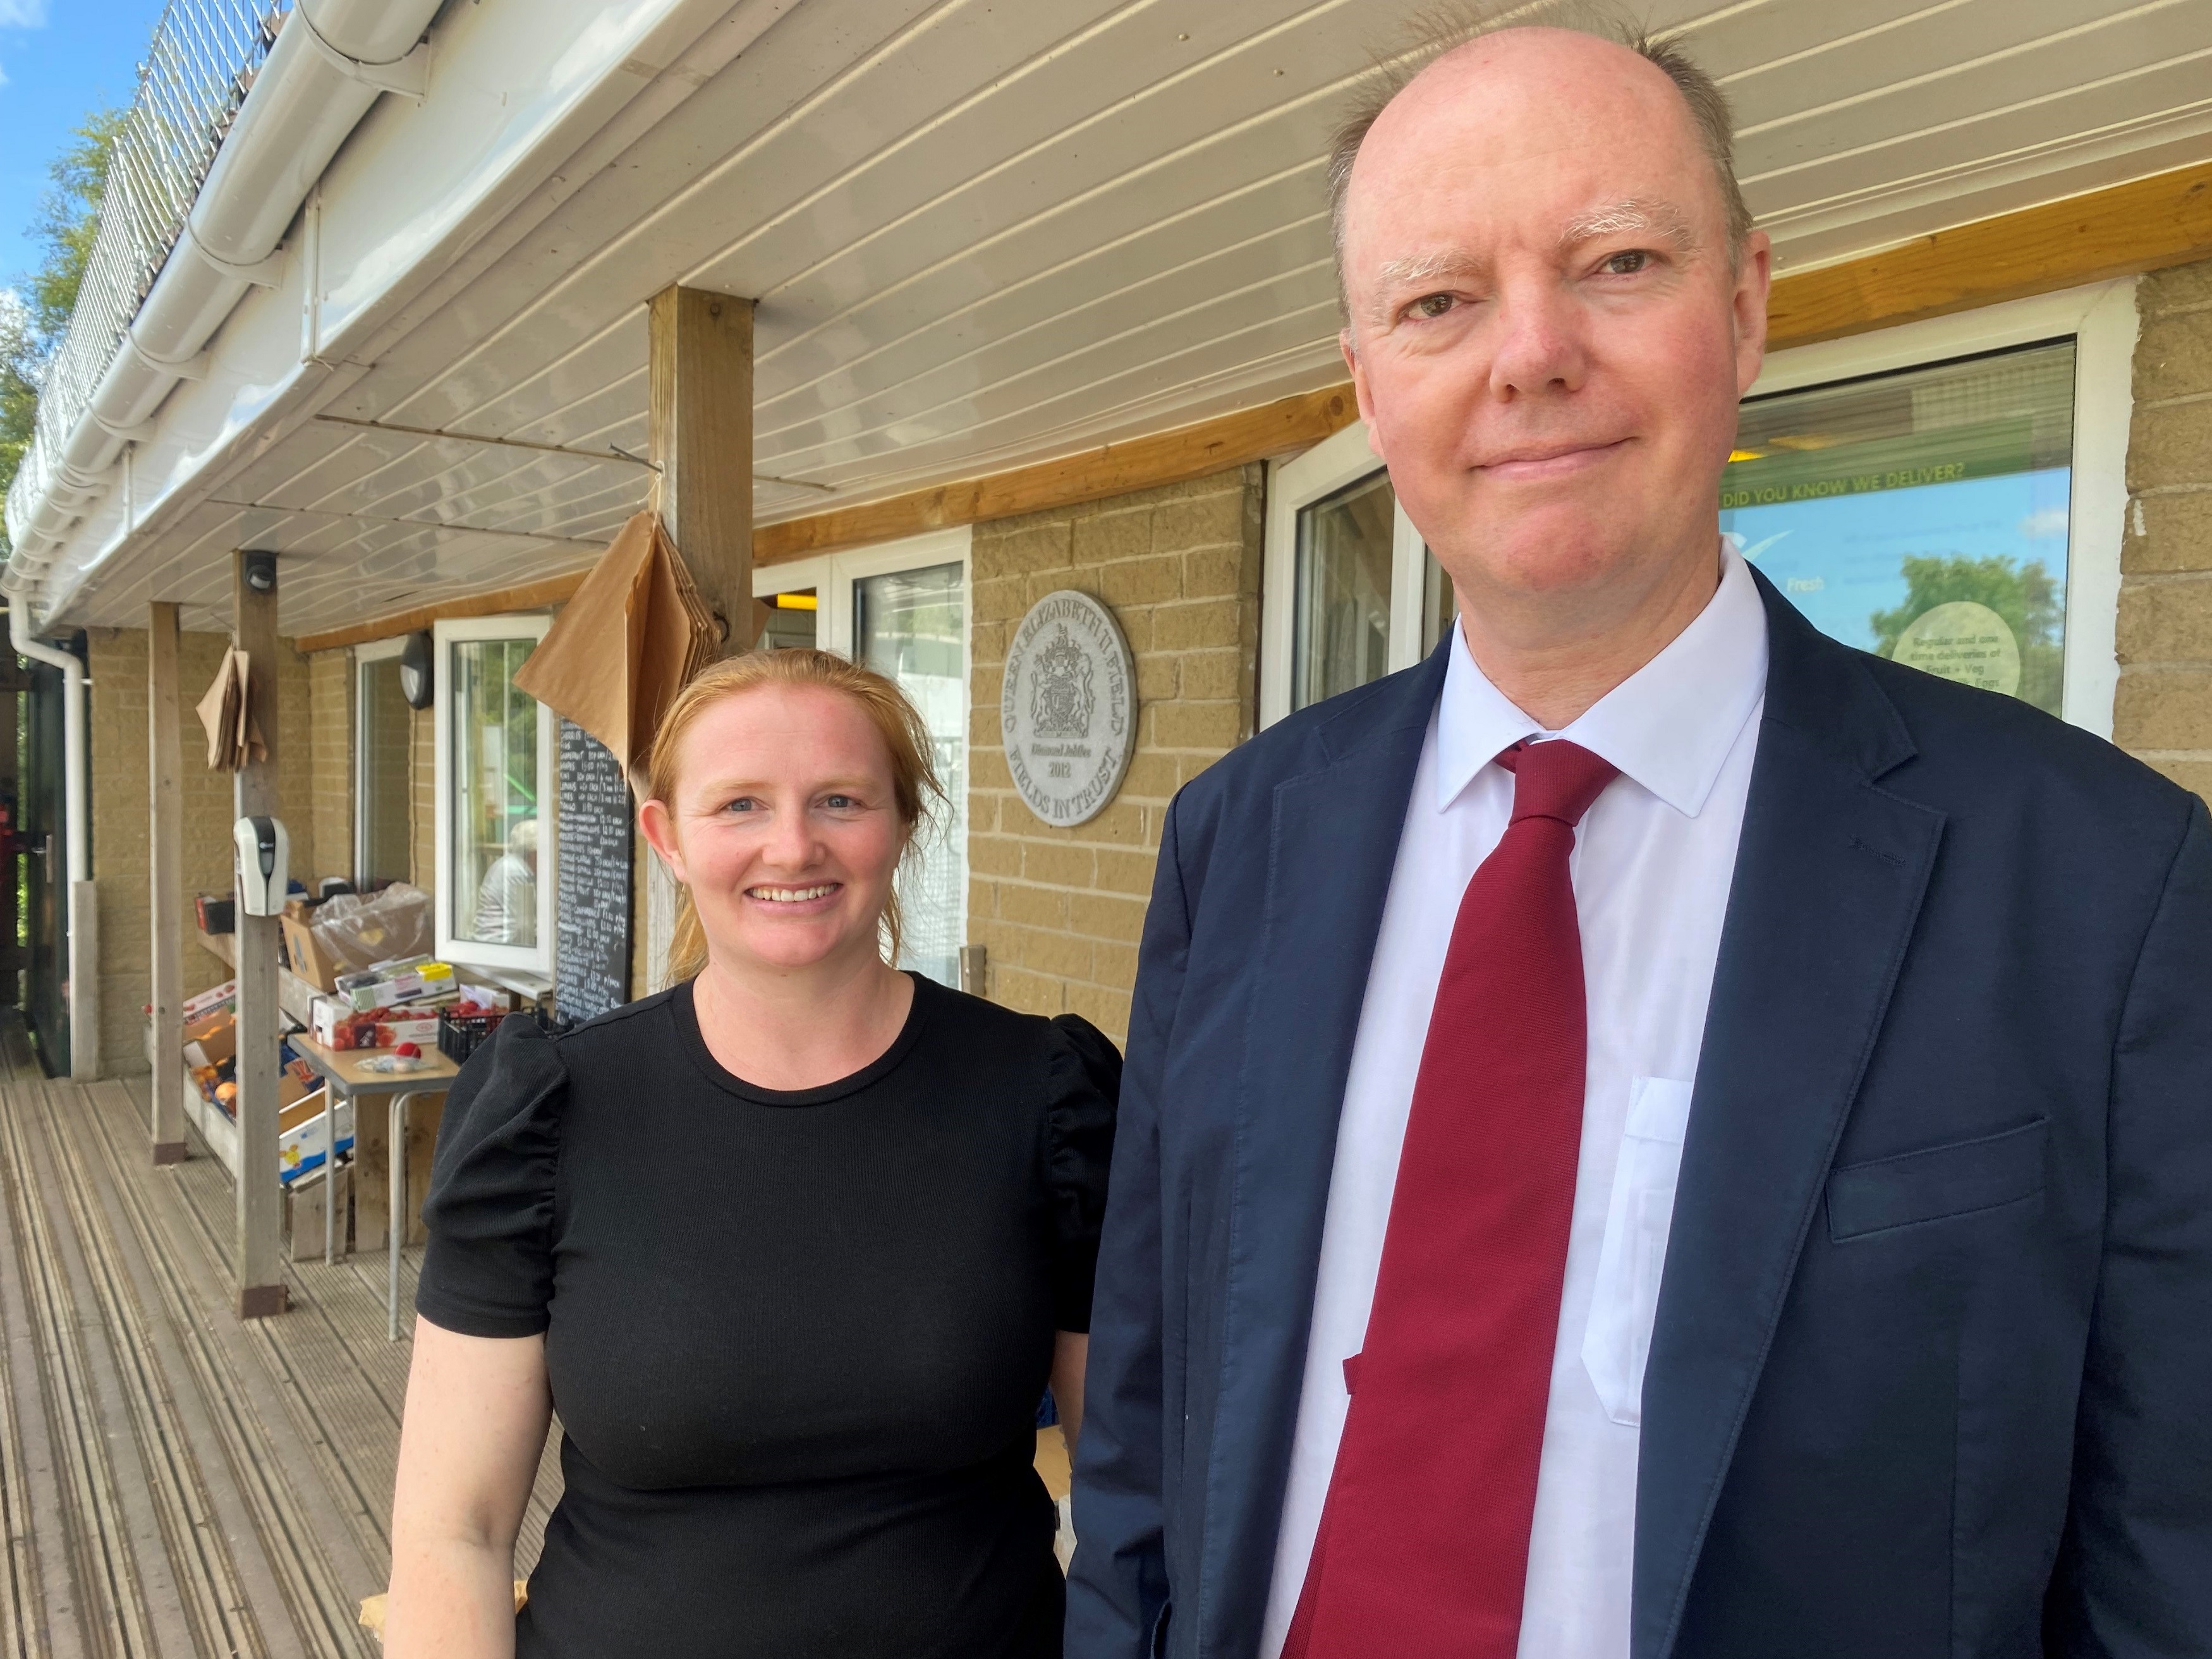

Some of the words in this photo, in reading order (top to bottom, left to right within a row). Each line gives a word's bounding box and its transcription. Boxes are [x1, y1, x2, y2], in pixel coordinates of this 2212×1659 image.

[1723, 490, 1749, 507] DID
[1754, 487, 1787, 504] YOU
[1792, 480, 1847, 499] KNOW
[1852, 474, 1881, 491] WE
[1887, 462, 1965, 486] DELIVER?
[1787, 576, 1824, 592] Fresh
[1023, 598, 1103, 648] ELIZABETH
[1099, 628, 1114, 655] II
[1910, 652, 1935, 661] time
[1936, 648, 1987, 660] deliveries
[1990, 648, 2002, 658] of
[1912, 636, 1954, 648] Regular
[1955, 634, 1976, 645] and
[1926, 664, 1950, 674] Fruit
[1964, 664, 1984, 676] Veg
[1003, 641, 1023, 734] QUEEN
[1106, 650, 1124, 736] FIELD
[1009, 743, 1051, 814] FIELDS
[1052, 798, 1071, 819] IN
[1071, 746, 1117, 815] TRUST
[1048, 762, 1071, 778] 2012
